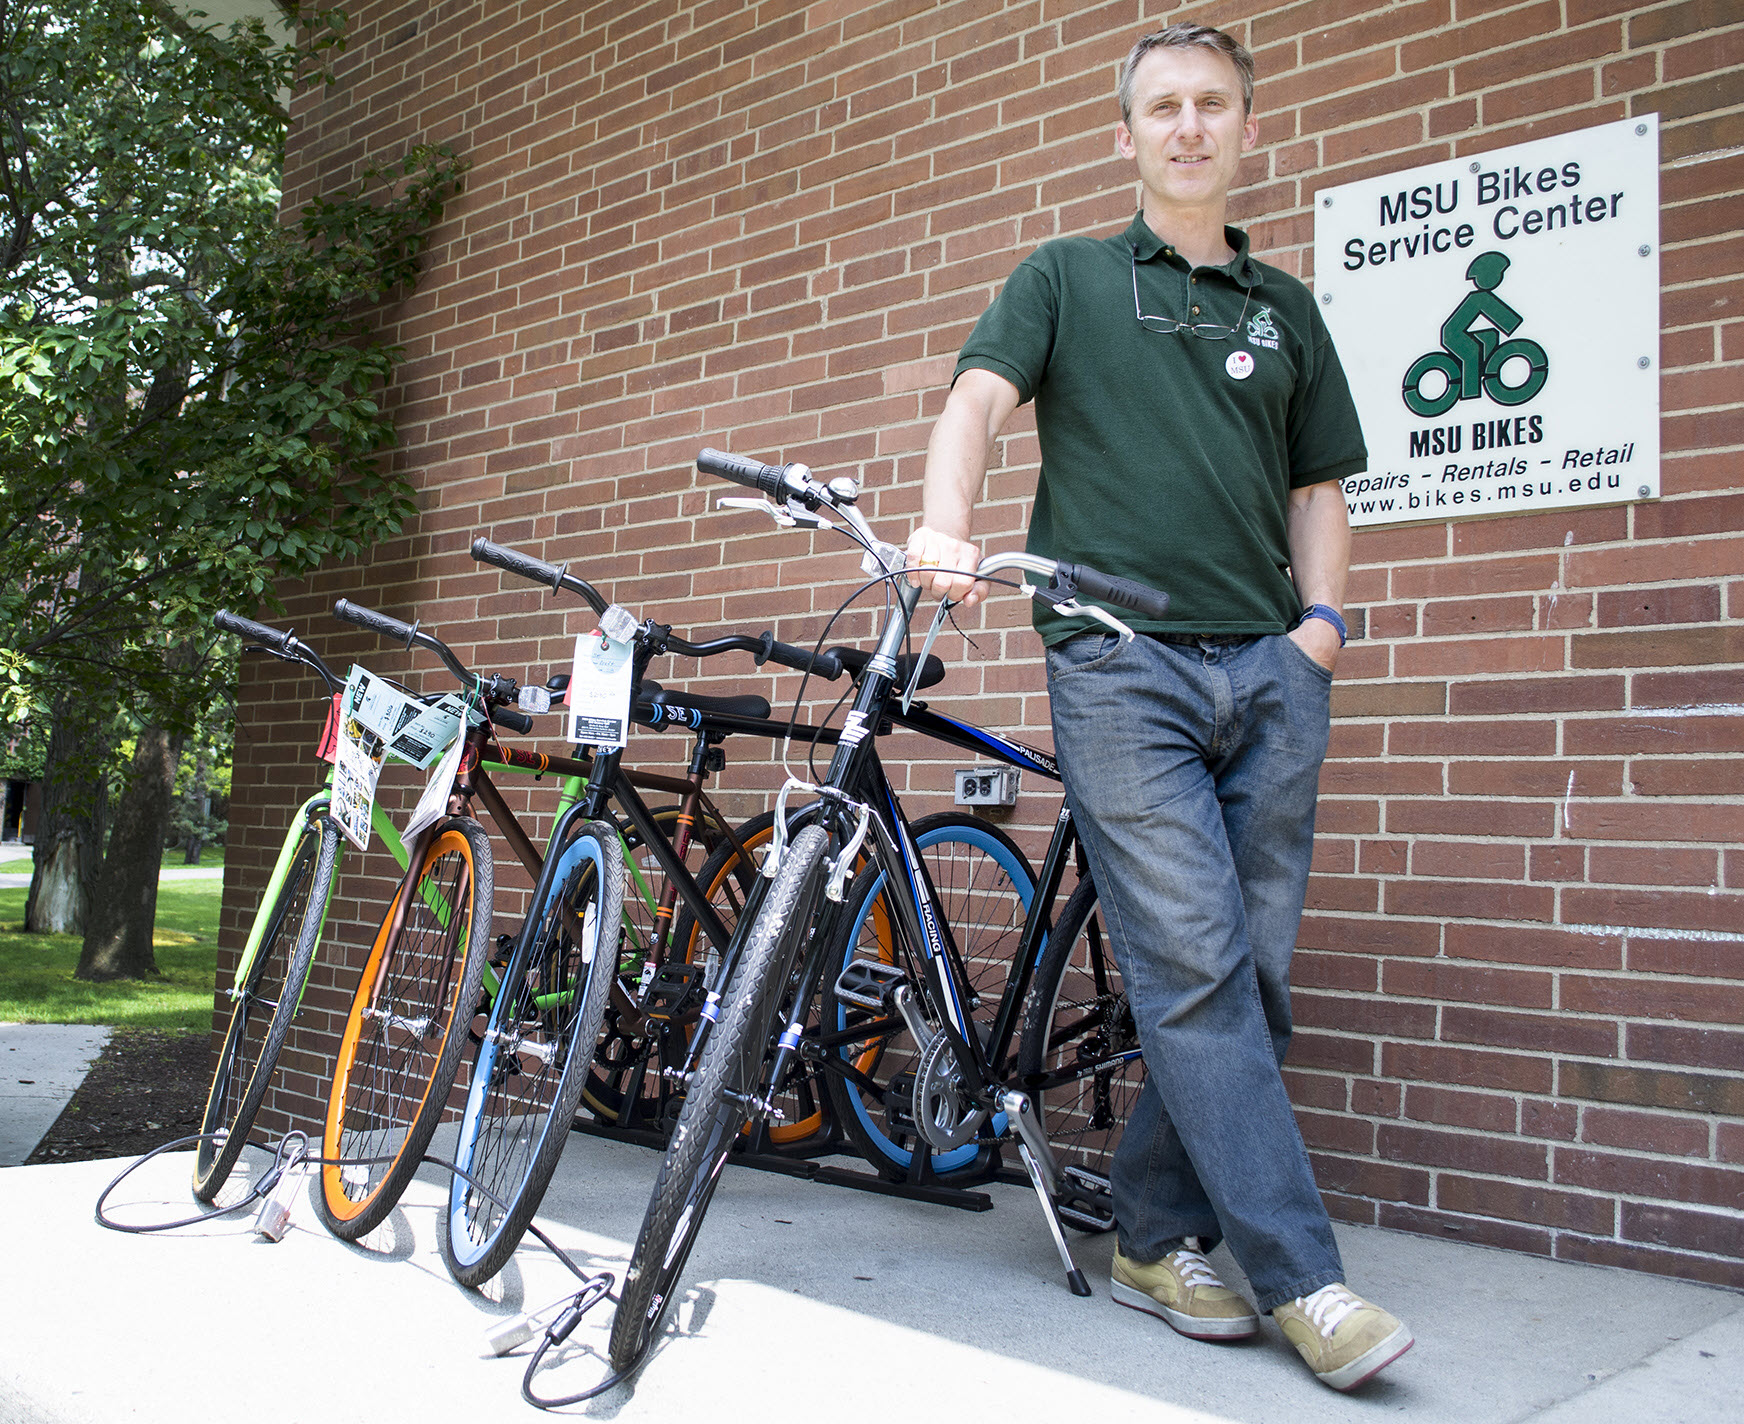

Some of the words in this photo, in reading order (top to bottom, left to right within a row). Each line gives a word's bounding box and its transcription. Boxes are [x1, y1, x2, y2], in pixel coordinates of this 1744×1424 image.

[1379, 179, 1459, 227] MSU
[1477, 161, 1582, 206] Bikes
[1343, 223, 1475, 272] Service
[1493, 191, 1624, 240] Center
[1230, 365, 1251, 375] MSU
[1409, 424, 1462, 459] MSU
[1472, 414, 1544, 452] BIKES
[1441, 456, 1528, 484] Rentals
[1562, 442, 1635, 470] Retail
[1347, 471, 1622, 515] www.bikes.msu.edu
[353, 682, 367, 705] NEW
[665, 704, 688, 722] SE
[515, 748, 536, 765] SE
[1019, 745, 1056, 772] PALISADE
[922, 904, 941, 953] RACING
